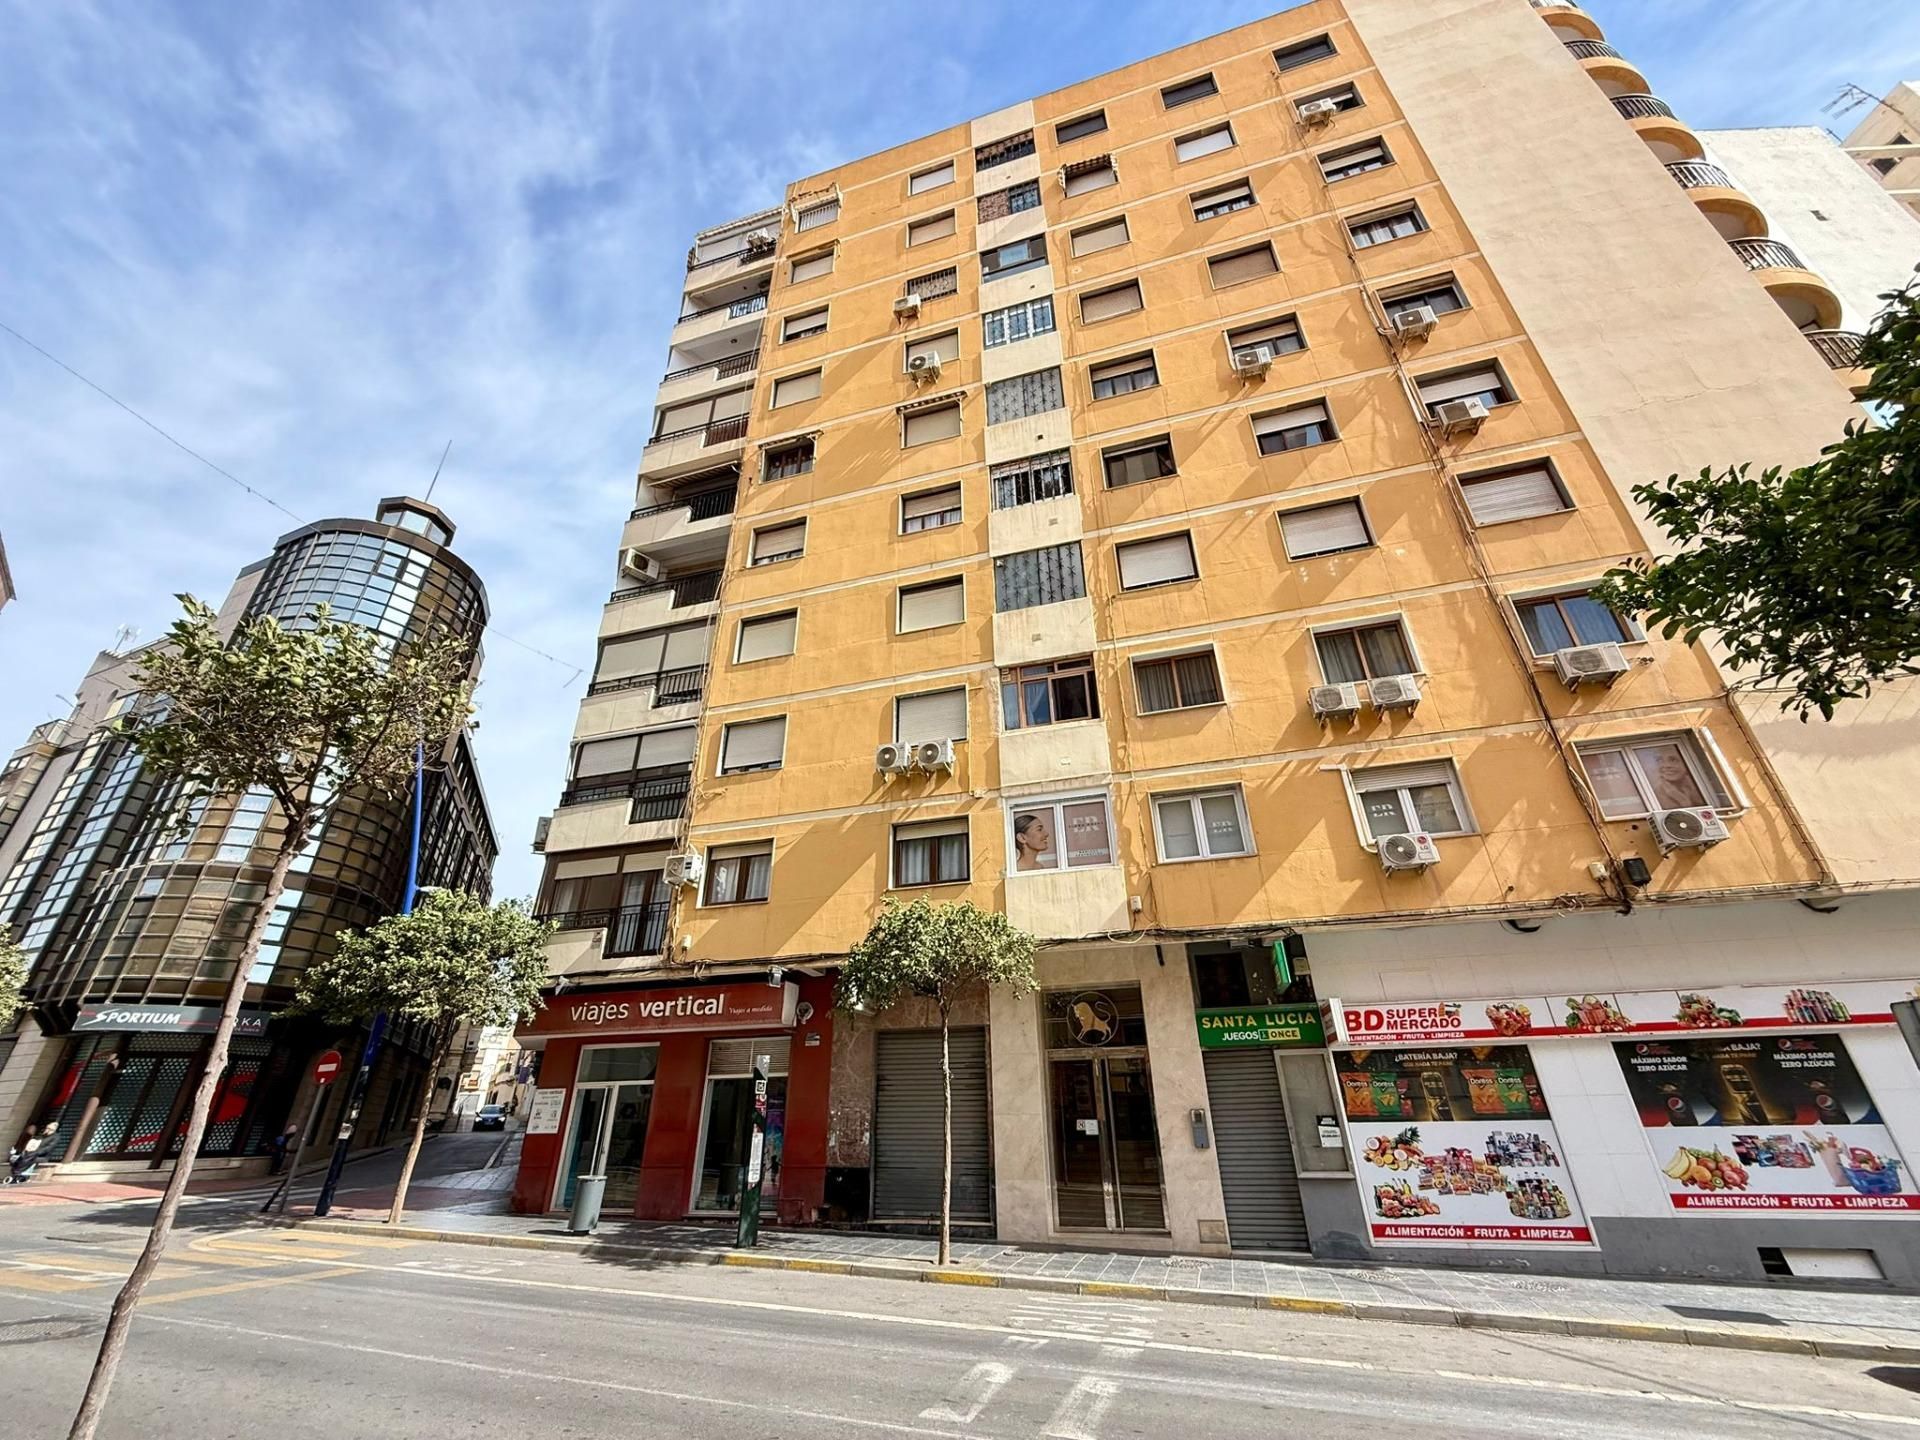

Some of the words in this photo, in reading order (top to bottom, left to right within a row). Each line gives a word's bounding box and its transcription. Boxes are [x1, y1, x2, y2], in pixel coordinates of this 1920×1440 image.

[571, 1001, 630, 1025] viajes
[639, 993, 725, 1018] vertical
[1386, 1007, 1438, 1019] SUPER
[81, 1008, 181, 1026] SPORTIUM
[1202, 1015, 1257, 1029] SANTA
[1265, 1012, 1316, 1026] LUCIA
[1343, 1009, 1385, 1032] BD
[1386, 1017, 1462, 1031] MERCADO
[1222, 1030, 1259, 1041] JUEGOS
[1270, 1029, 1299, 1038] ONCE
[1350, 1034, 1397, 1042] LIMENTACIÓN
[1431, 1031, 1465, 1039] LIMPIEZA
[1394, 1052, 1431, 1062] ¿BATERÍA
[1432, 1052, 1458, 1060] BAJA?
[1630, 1056, 1661, 1064] MÁXIMO
[1773, 1052, 1807, 1060] MÁXIMO
[1807, 1051, 1835, 1059] SABOR
[1657, 1063, 1688, 1071] AZÚCAR
[1803, 1059, 1836, 1067] AZÚCAR
[1346, 1080, 1368, 1088] Doritos
[1372, 1080, 1394, 1088] Doritos
[1470, 1078, 1494, 1086] Doritos
[1498, 1077, 1522, 1085] Doritos
[1686, 1196, 1780, 1207] ALIMENTACIÓN
[1791, 1197, 1833, 1208] FRUTA
[1844, 1197, 1908, 1208] LIMPIEZA
[1385, 1225, 1464, 1238] ALIMENTACIÓN
[1474, 1228, 1511, 1238] FRUTA
[1520, 1228, 1574, 1240] LIMPIEZA
